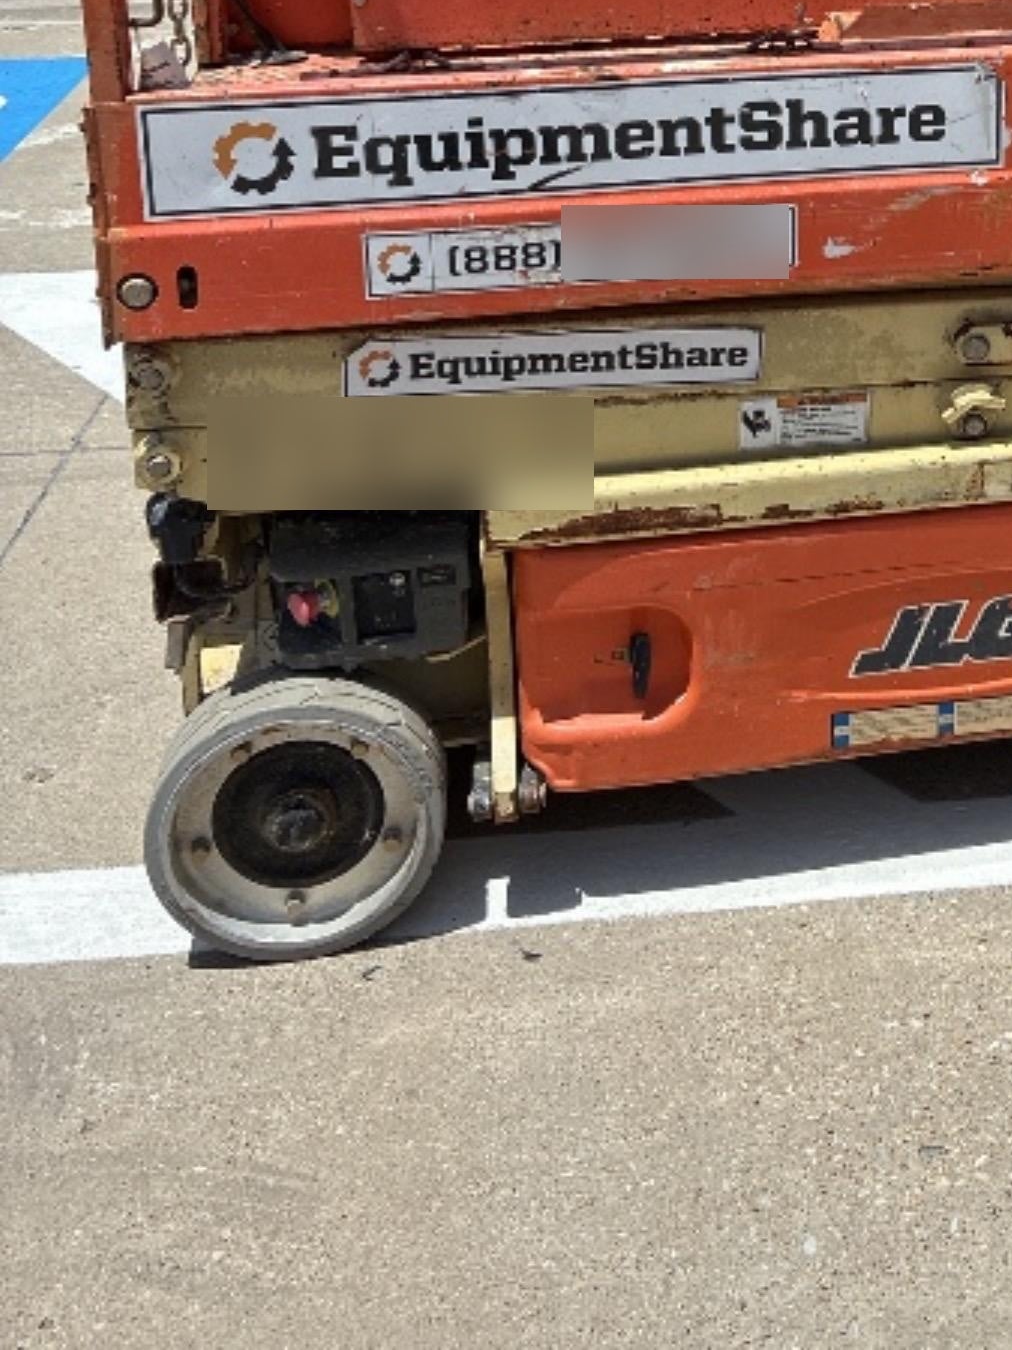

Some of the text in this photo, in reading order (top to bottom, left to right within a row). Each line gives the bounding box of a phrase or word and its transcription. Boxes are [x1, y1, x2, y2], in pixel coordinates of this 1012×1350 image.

[311, 98, 946, 188] EquipmentShare
[449, 240, 561, 277] (888)
[408, 341, 749, 385] EquipmentShare
